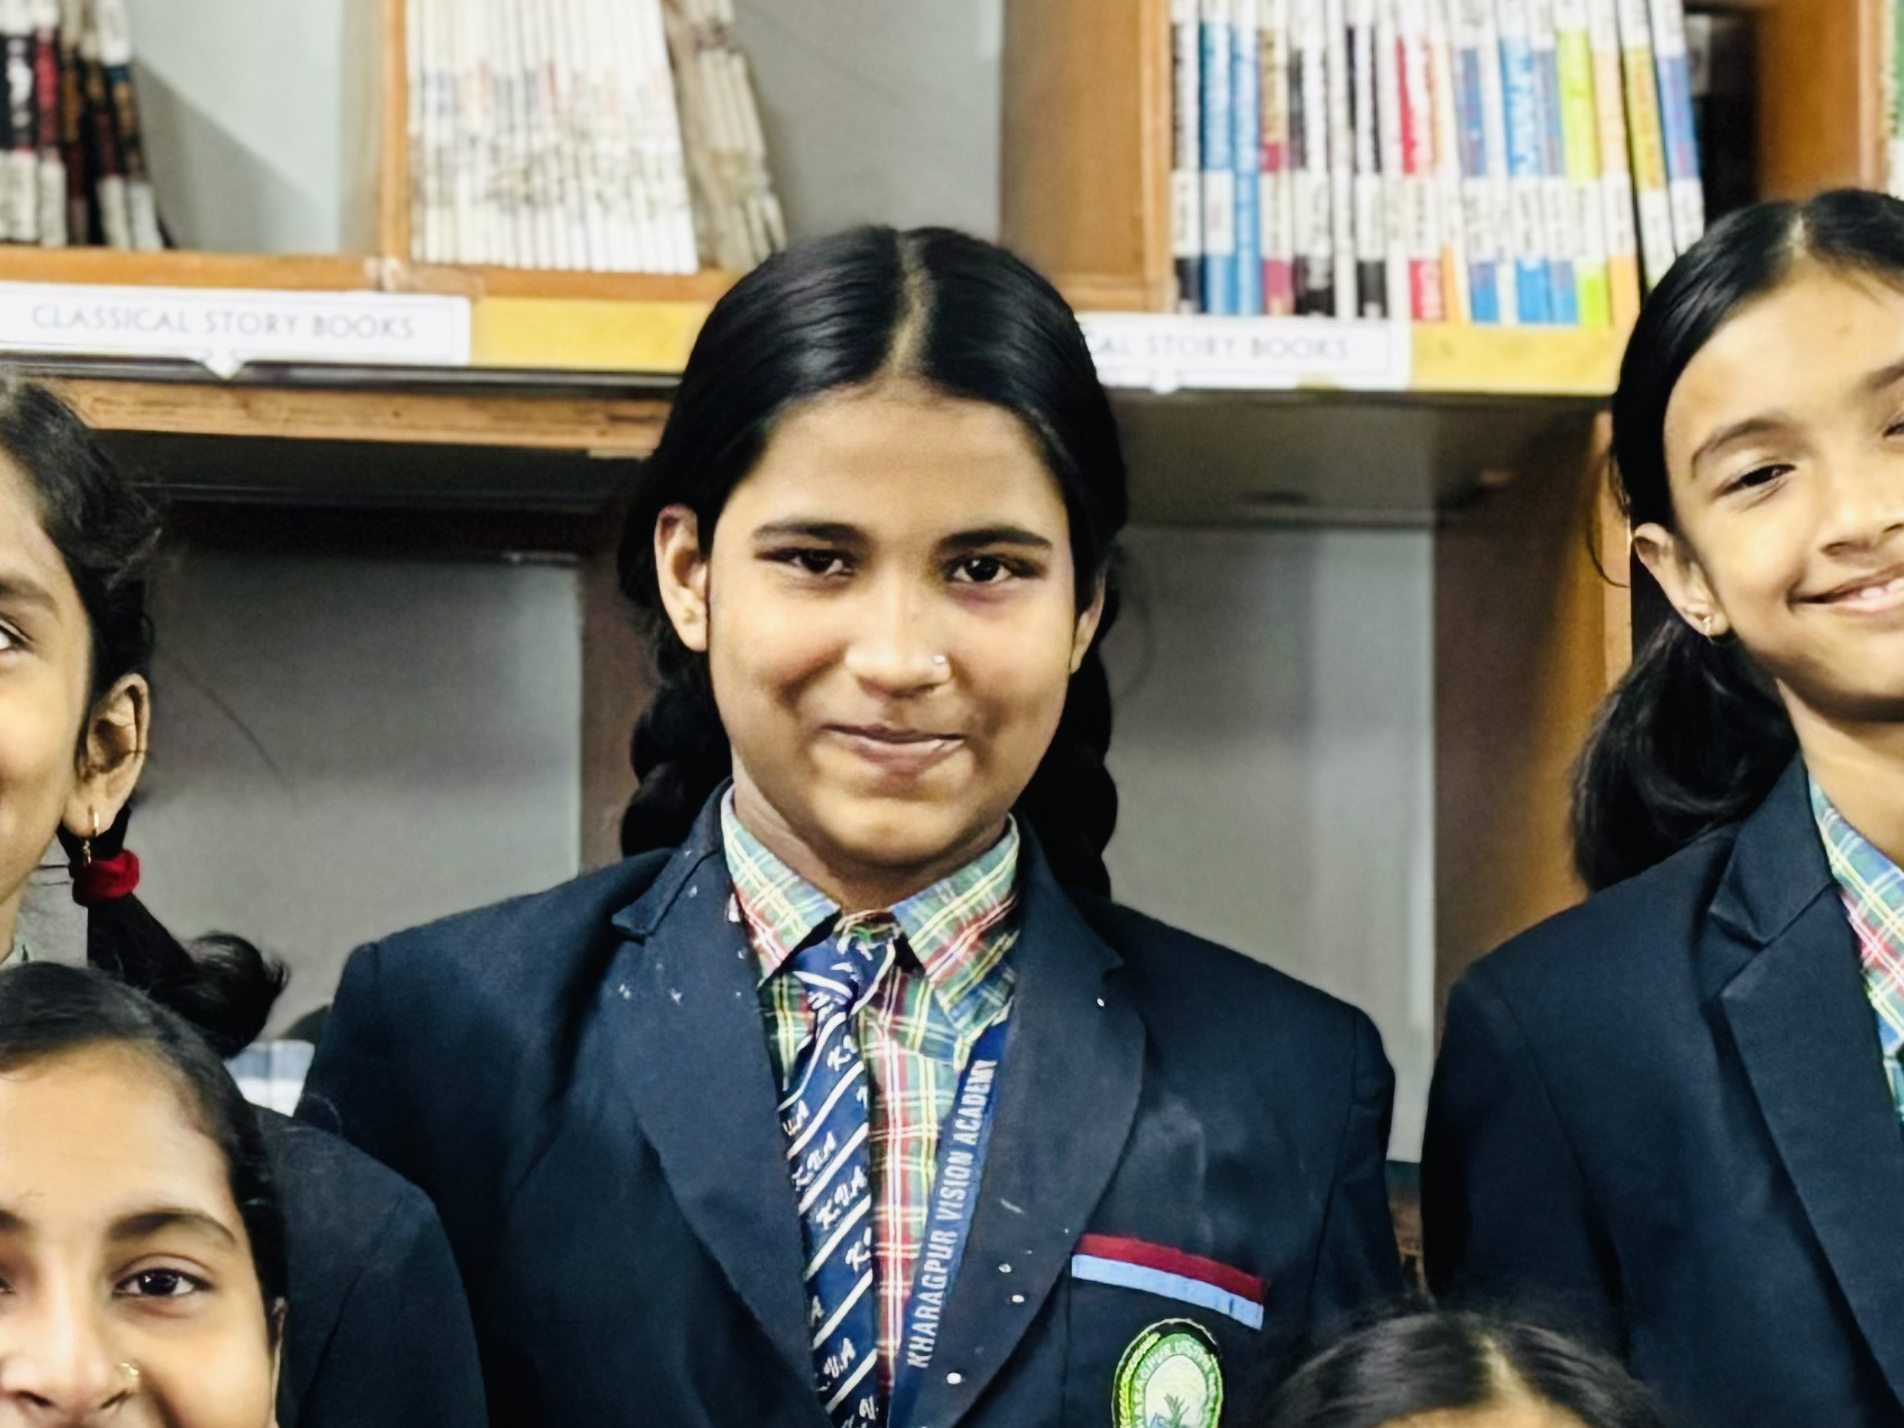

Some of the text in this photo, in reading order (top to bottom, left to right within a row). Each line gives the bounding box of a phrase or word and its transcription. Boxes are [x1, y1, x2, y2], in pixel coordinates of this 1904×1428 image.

[32, 302, 415, 341] CLASSICAL STORY BOOKS
[1147, 334, 1237, 360] STORY
[1251, 337, 1348, 362] BOOKS
[907, 1230, 958, 1368] KHARAGPUR
[935, 1150, 975, 1222] VISION
